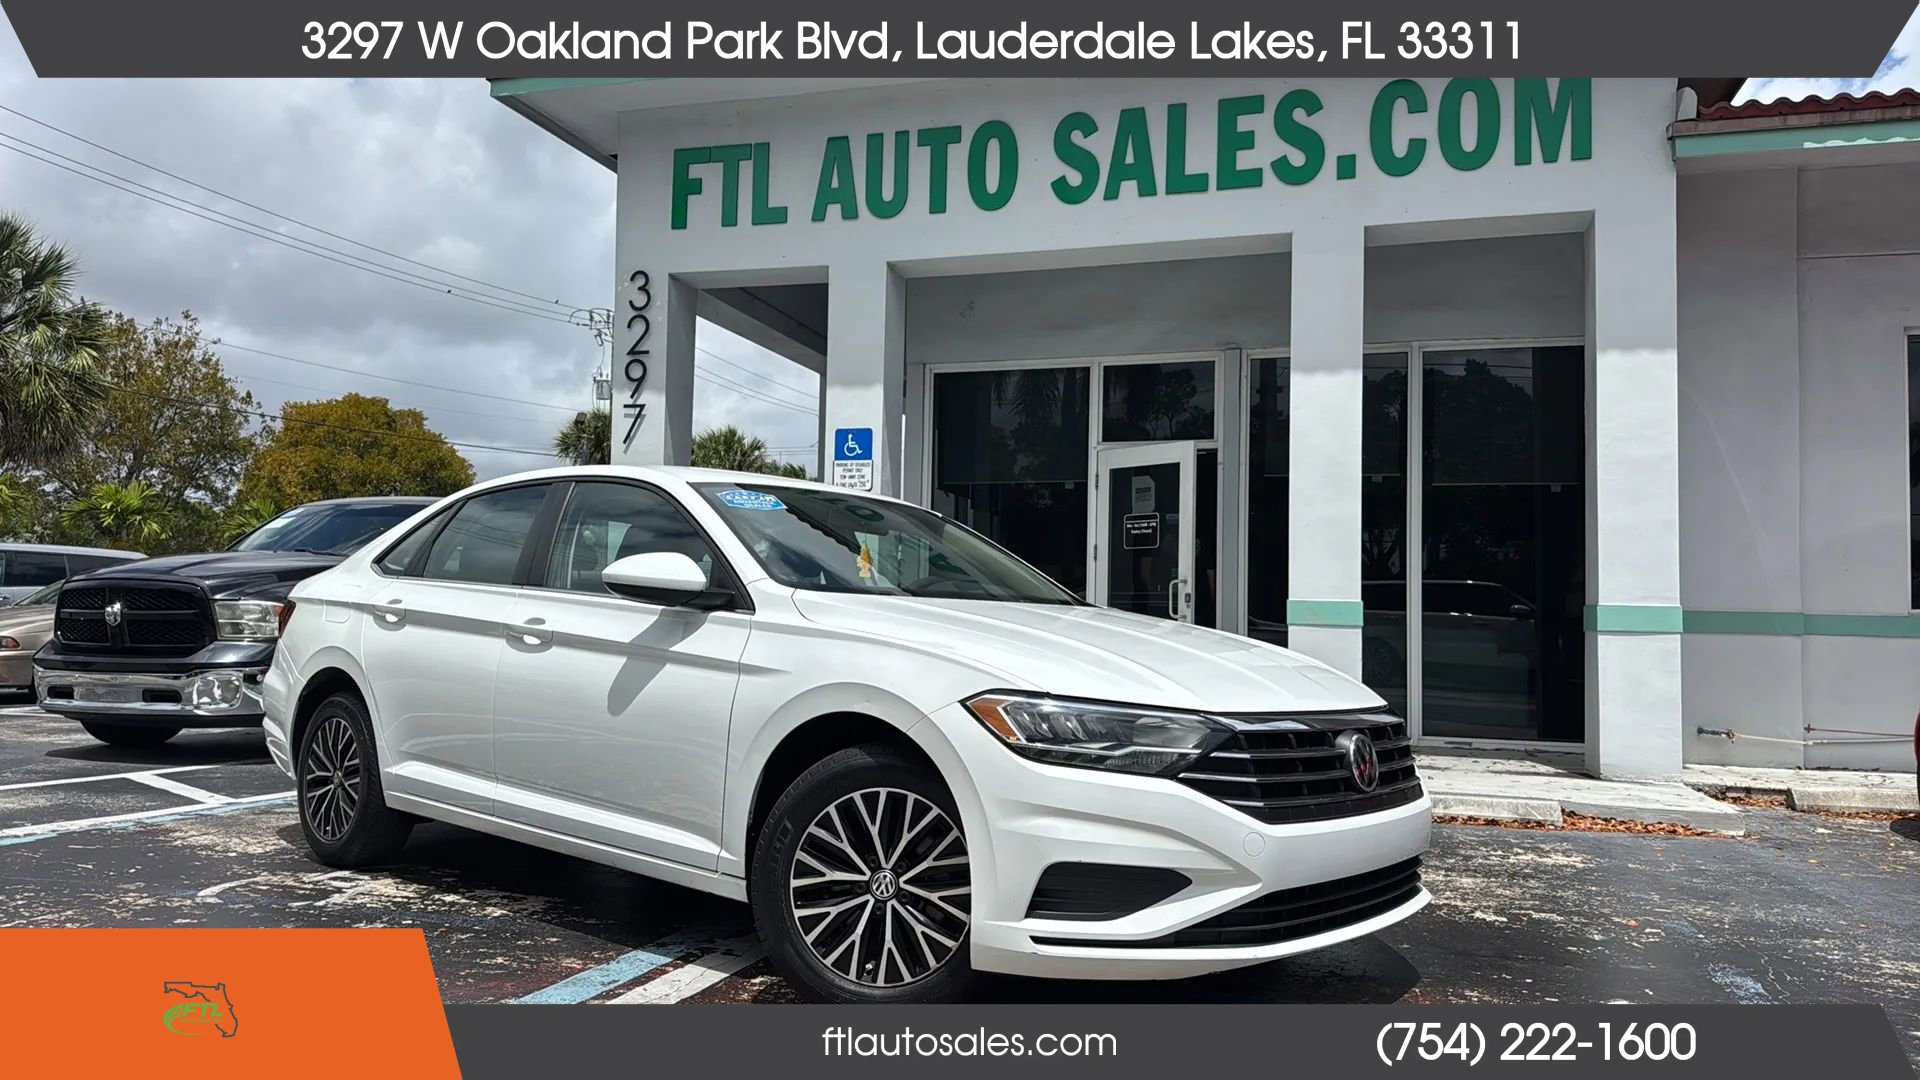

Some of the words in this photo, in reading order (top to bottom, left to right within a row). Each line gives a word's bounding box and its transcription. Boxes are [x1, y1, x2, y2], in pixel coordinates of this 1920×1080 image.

[671, 142, 788, 230] FTL
[811, 120, 1019, 222] AUTO
[1051, 79, 1592, 205] SALES.COM
[622, 270, 652, 445] 3297
